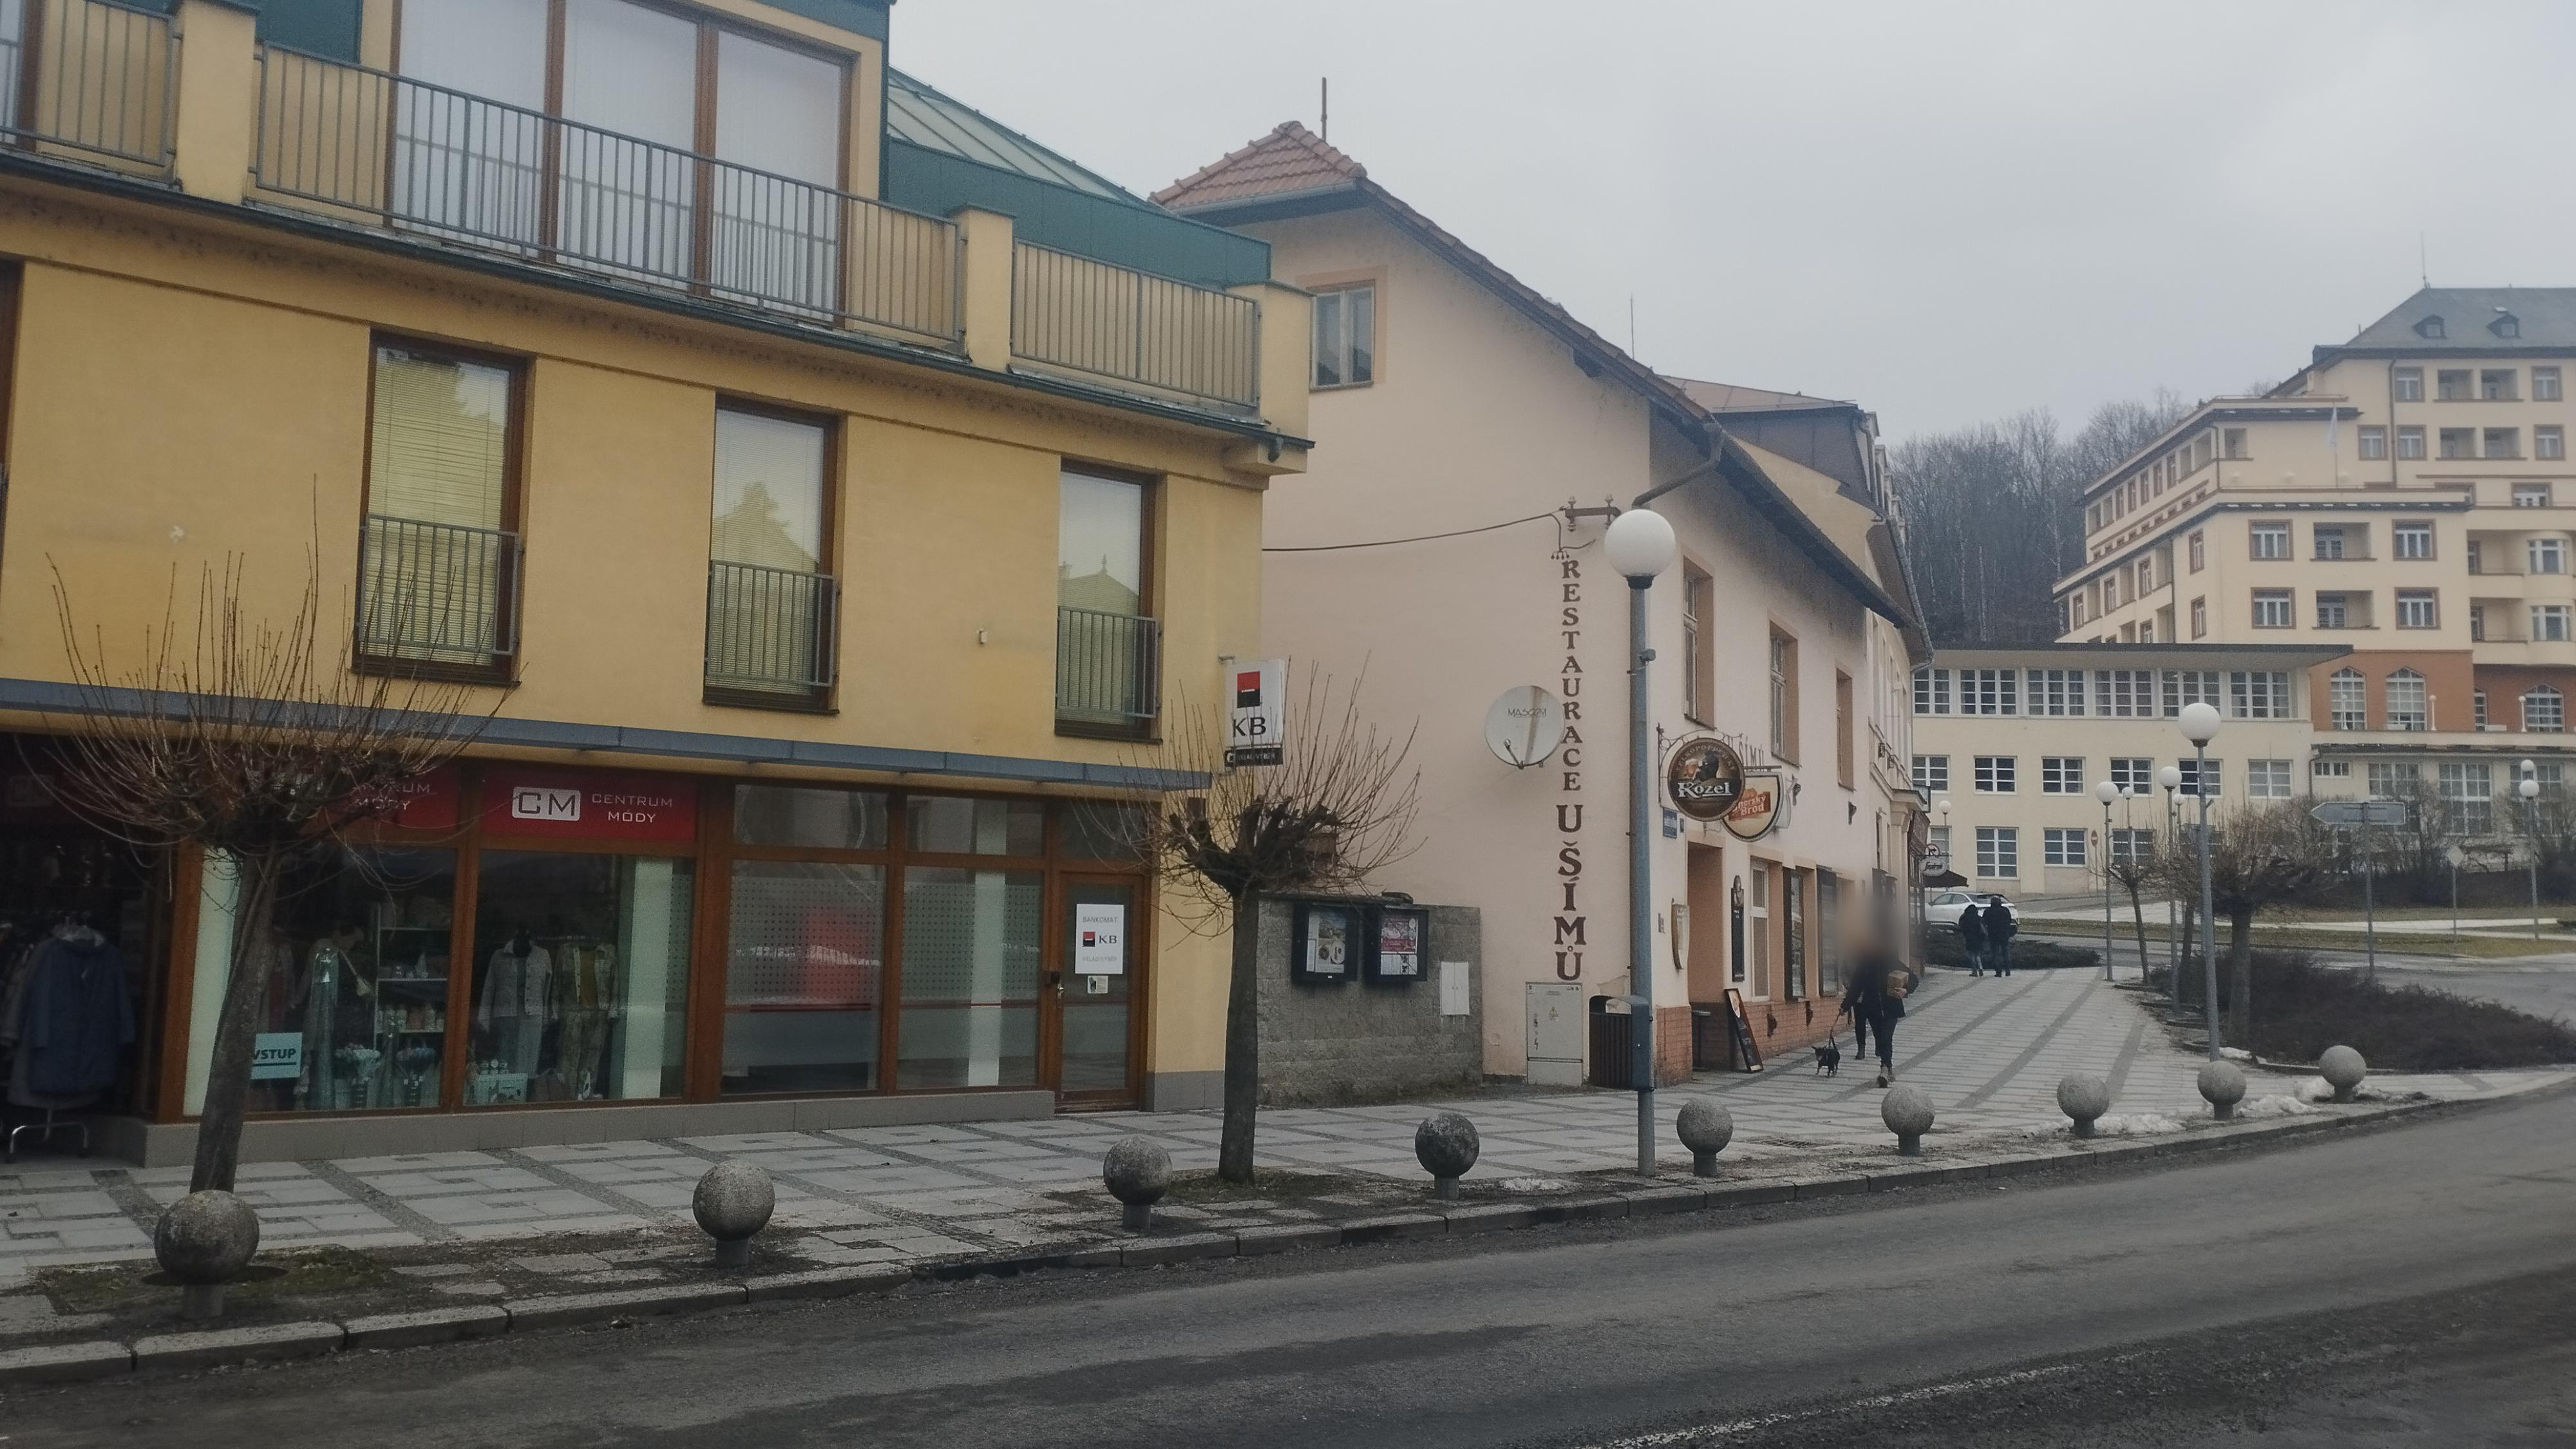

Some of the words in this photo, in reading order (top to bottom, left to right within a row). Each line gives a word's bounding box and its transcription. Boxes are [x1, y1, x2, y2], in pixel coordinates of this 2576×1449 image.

[1560, 560, 1582, 791] RESTAURACE
[1233, 717, 1266, 737] KB
[591, 793, 672, 808] CENTRUM
[1678, 782, 1734, 799] Kozel
[518, 791, 576, 817] CM
[1741, 802, 1765, 815] Brod
[1555, 804, 1584, 833] U
[1553, 840, 1587, 981] ŠÍMŮ
[1099, 935, 1117, 944] KB
